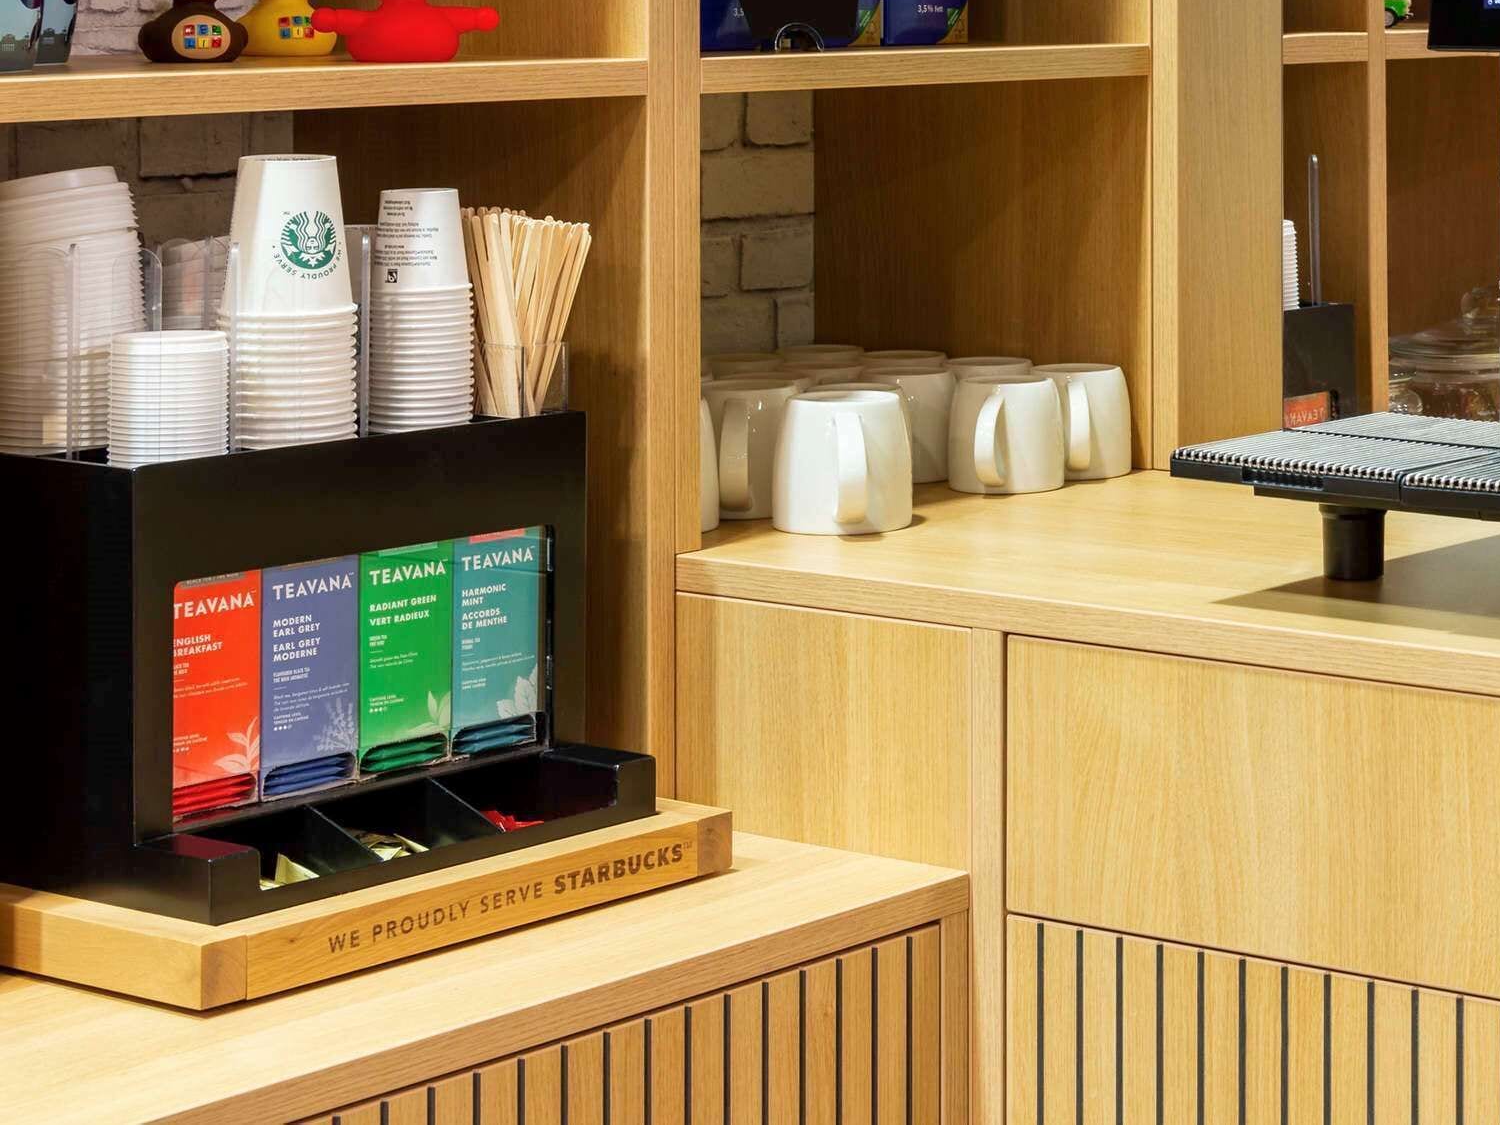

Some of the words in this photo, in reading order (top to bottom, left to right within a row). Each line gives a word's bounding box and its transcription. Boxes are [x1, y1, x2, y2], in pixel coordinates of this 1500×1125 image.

[273, 253, 298, 276] SERVE
[461, 583, 507, 597] HARMONIC
[173, 591, 255, 620] TEAVANA
[369, 598, 409, 613] RADIANT
[410, 594, 438, 606] GREEN
[461, 596, 484, 607] MINT
[273, 614, 312, 628] MODERN
[369, 616, 392, 626] VERT
[393, 609, 430, 624] RADIEUX
[461, 607, 501, 621] ACCORDS
[273, 627, 296, 638] EARL
[298, 622, 320, 634] GREY
[461, 621, 473, 630] DE
[475, 616, 508, 628] MENTHE
[273, 642, 296, 652] EARL
[298, 637, 321, 648] GREY
[273, 647, 318, 662] MODERNE
[328, 929, 361, 954] WE
[372, 900, 471, 943] PROUDLY
[479, 881, 543, 914] SERVE
